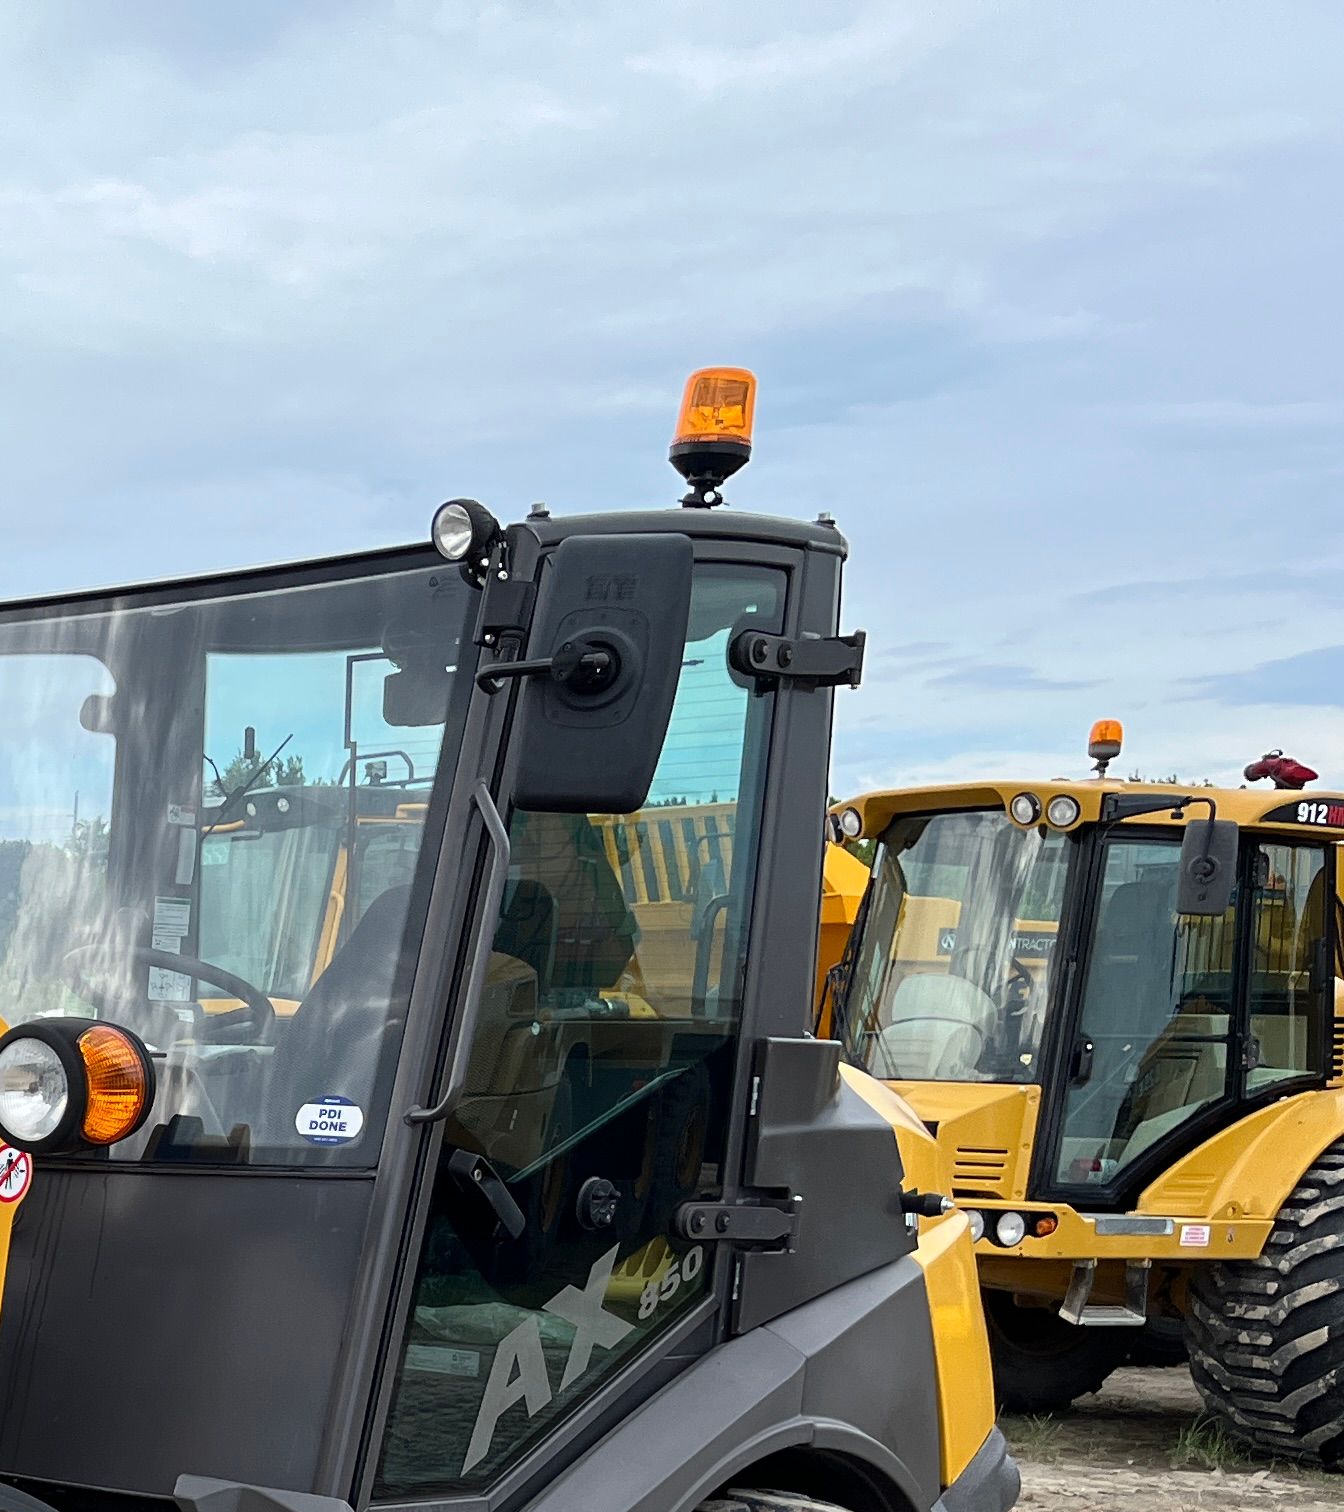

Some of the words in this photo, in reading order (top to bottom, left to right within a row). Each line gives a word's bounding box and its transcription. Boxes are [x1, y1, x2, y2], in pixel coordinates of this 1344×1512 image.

[318, 1108, 342, 1120] PDI
[308, 1120, 348, 1132] DONE
[460, 1242, 637, 1478] AX
[638, 1245, 704, 1320] 850
